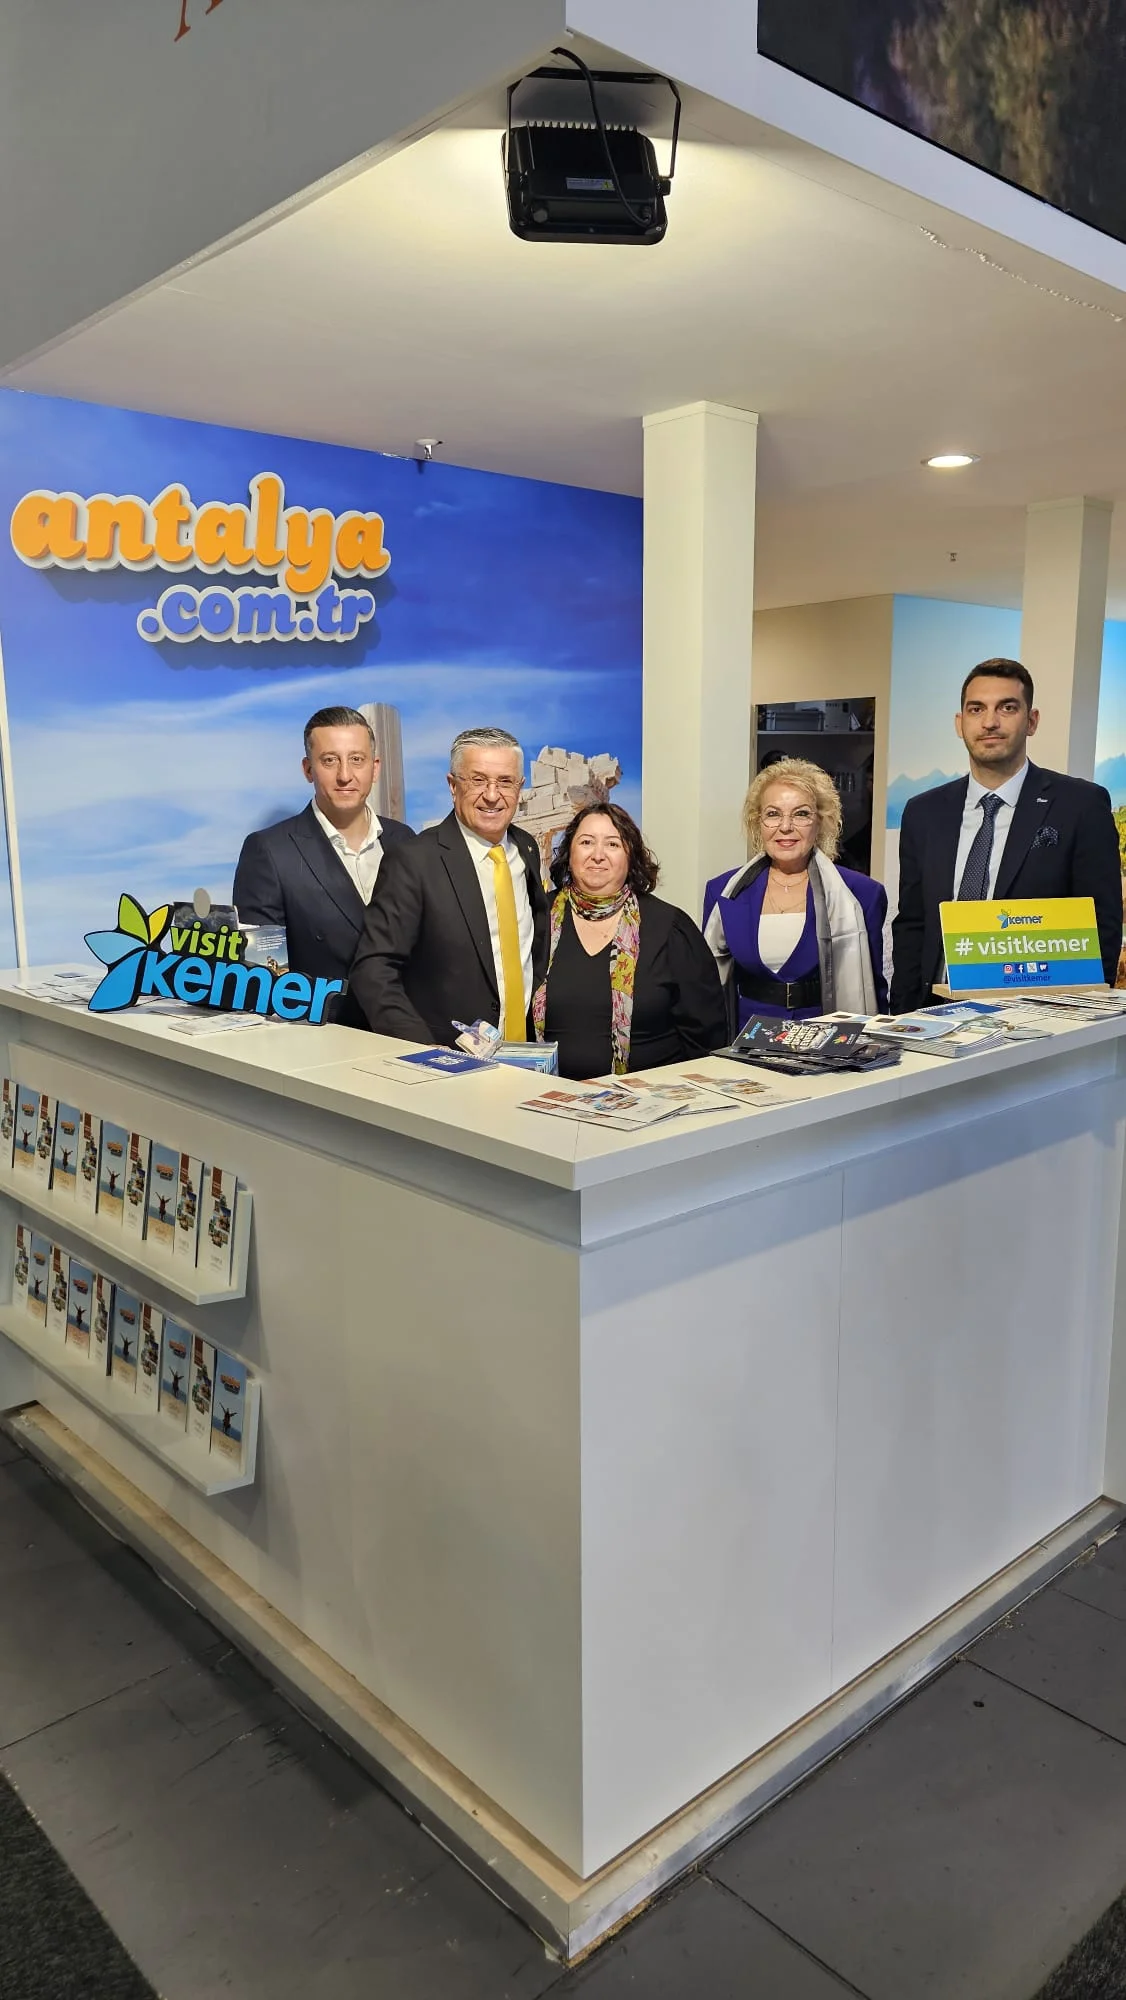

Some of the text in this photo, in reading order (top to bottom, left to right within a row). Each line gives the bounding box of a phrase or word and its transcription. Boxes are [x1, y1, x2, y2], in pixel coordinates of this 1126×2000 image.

[15, 479, 389, 593] antalya
[141, 585, 373, 635] .com.tr
[171, 921, 242, 961] visit
[1008, 915, 1043, 925] kemer
[140, 951, 343, 1024] kemer
[1003, 974, 1051, 984] @visitkemer
